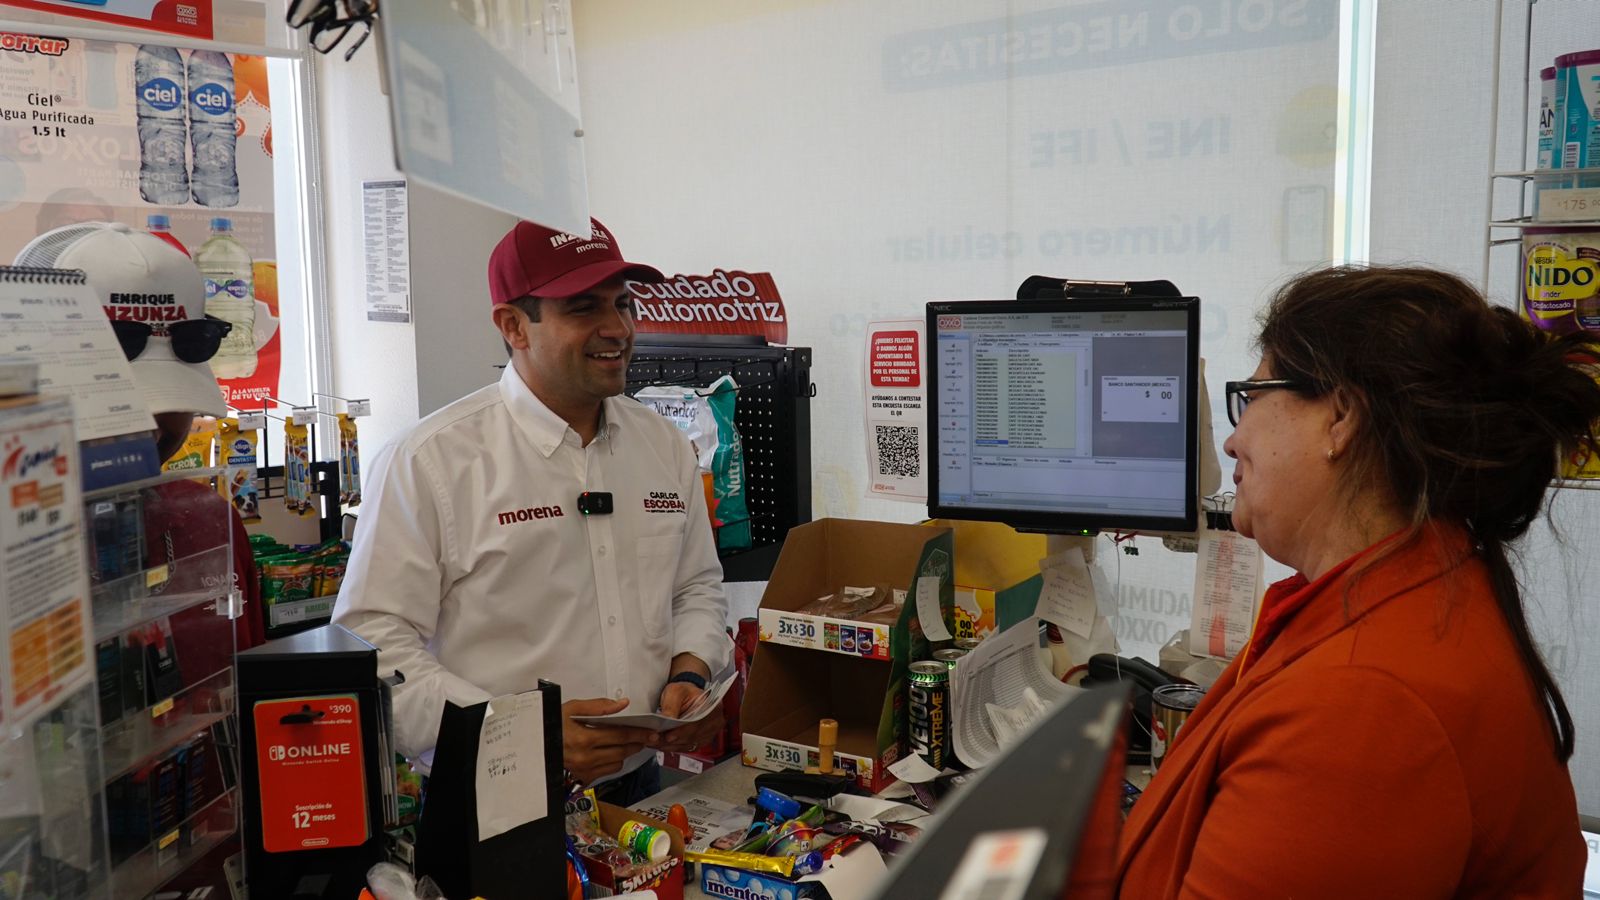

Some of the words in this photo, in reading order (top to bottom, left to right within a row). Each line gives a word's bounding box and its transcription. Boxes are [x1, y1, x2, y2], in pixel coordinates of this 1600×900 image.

[144, 84, 177, 103] ciel
[196, 89, 228, 107] ciel
[32, 109, 95, 126] Purificada
[32, 125, 51, 137] 1.5
[575, 242, 609, 254] morena
[1528, 265, 1594, 286] NIDO
[627, 270, 756, 299] Cuidado
[110, 293, 175, 305] ENRIQUE
[103, 305, 188, 321] NZUNZA
[634, 298, 784, 323] Automotriz
[939, 319, 961, 328] OXXO
[655, 401, 697, 422] Nutradog
[649, 491, 679, 499] CARLOS
[498, 504, 564, 525] morena
[329, 704, 352, 714] $390
[931, 691, 943, 748] XTREME
[287, 743, 351, 758] ONLINE
[295, 803, 325, 811] Suscripción
[292, 812, 311, 829] 12
[312, 813, 336, 821] meses
[706, 881, 772, 900] mentos
